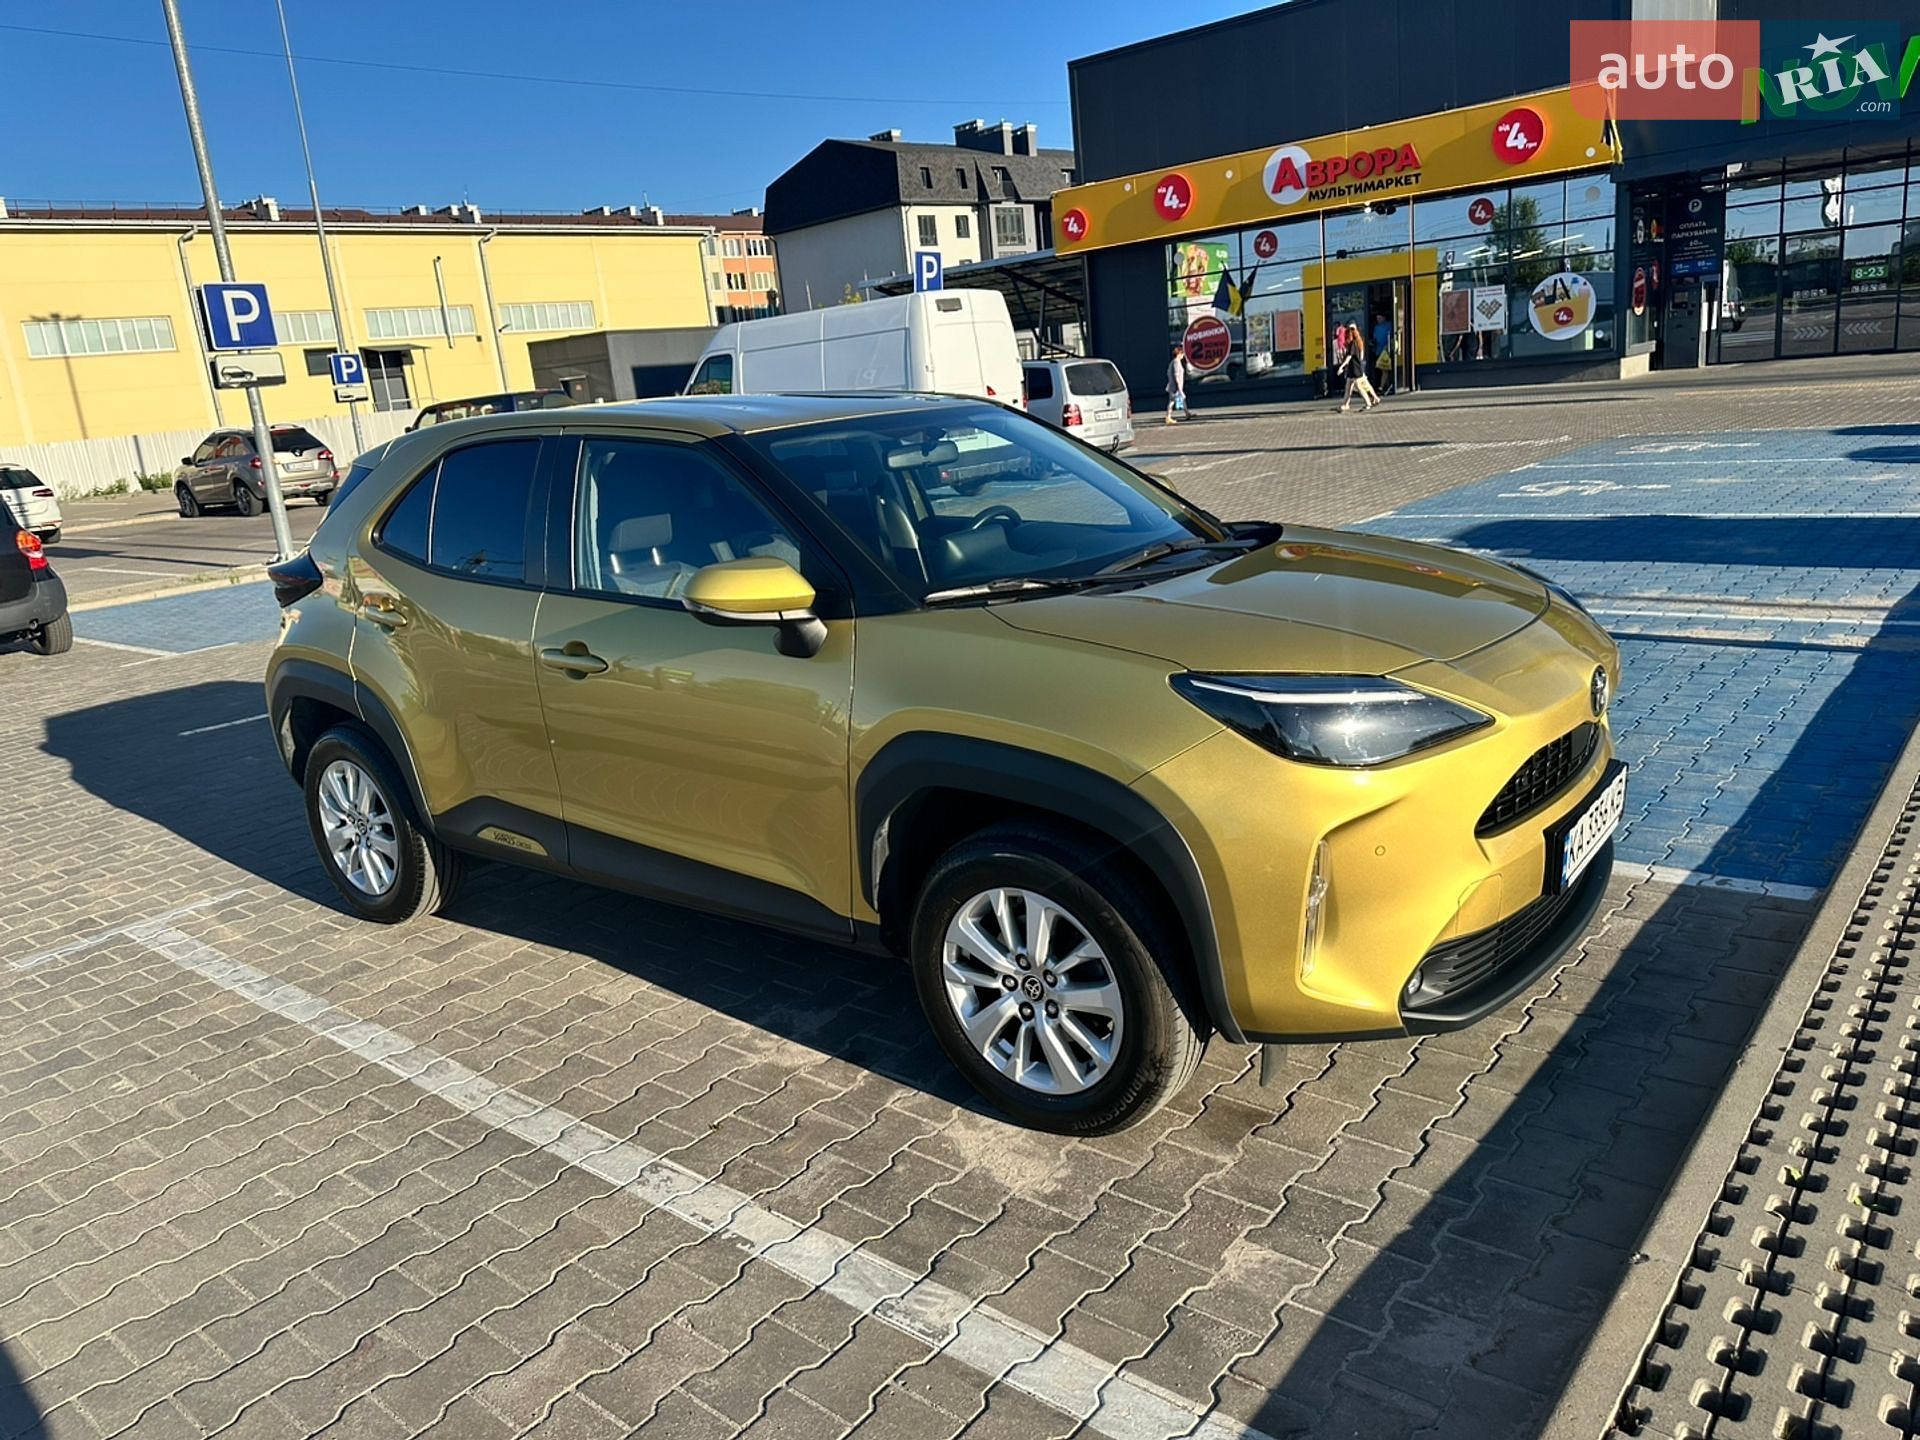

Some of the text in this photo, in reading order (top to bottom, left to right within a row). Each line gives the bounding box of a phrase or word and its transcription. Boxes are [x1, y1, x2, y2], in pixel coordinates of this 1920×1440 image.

[1506, 122, 1527, 149] 4
[1271, 143, 1421, 194] АВРОРА
[1163, 186, 1179, 209] 4
[1308, 173, 1421, 202] МУЛЬТИМАРКЕТ
[1068, 217, 1078, 233] 4
[921, 255, 938, 290] P
[1855, 266, 1884, 278] 8-23
[222, 290, 260, 341] P
[340, 357, 357, 382] P
